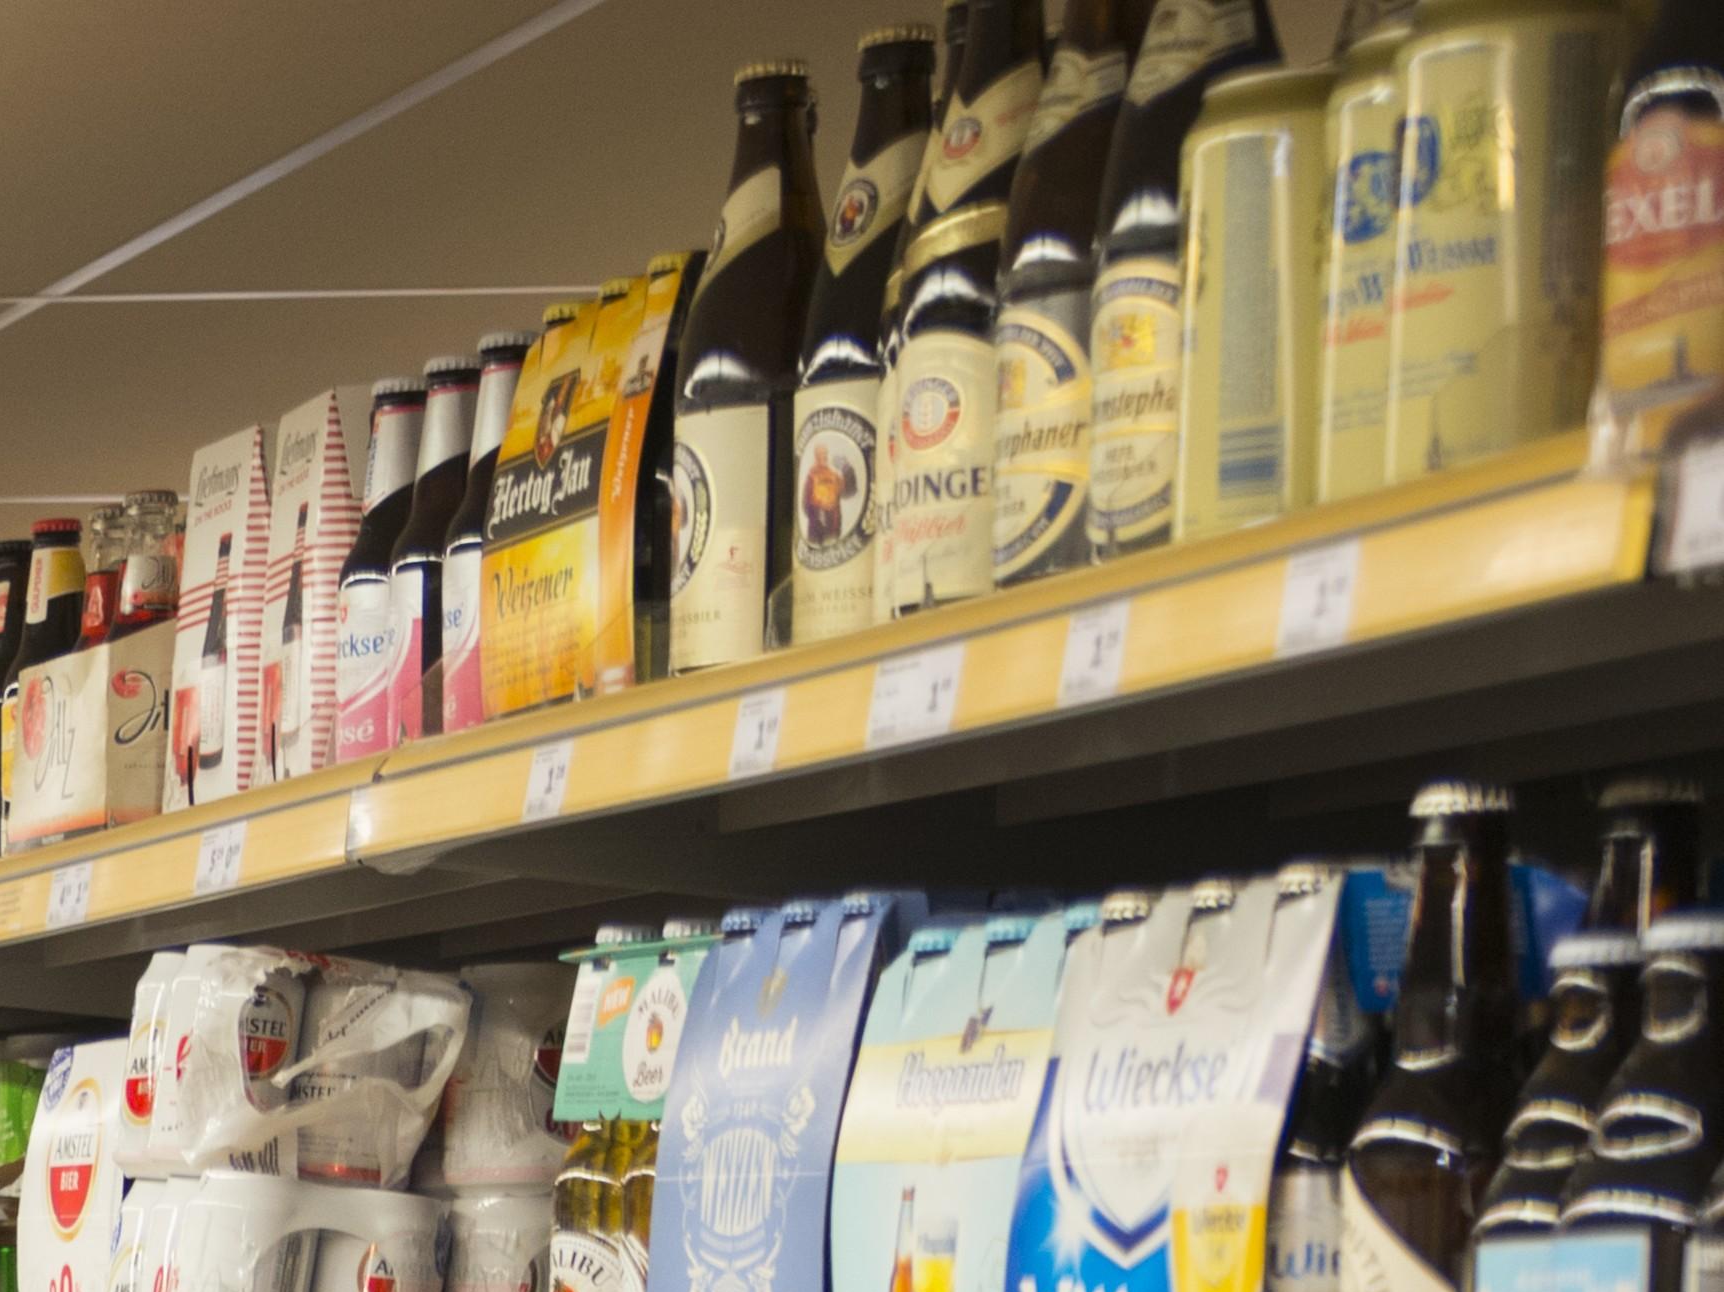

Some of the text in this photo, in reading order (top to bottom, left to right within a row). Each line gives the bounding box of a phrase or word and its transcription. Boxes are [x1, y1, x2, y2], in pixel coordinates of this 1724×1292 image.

[488, 445, 590, 539] Hertog Jan
[719, 1019, 796, 1072] Brand
[1083, 1033, 1230, 1112] Wieckse
[896, 1052, 1023, 1108] Hoegaarden
[55, 1135, 97, 1166] AMSTEL
[59, 1170, 80, 1192] BIER
